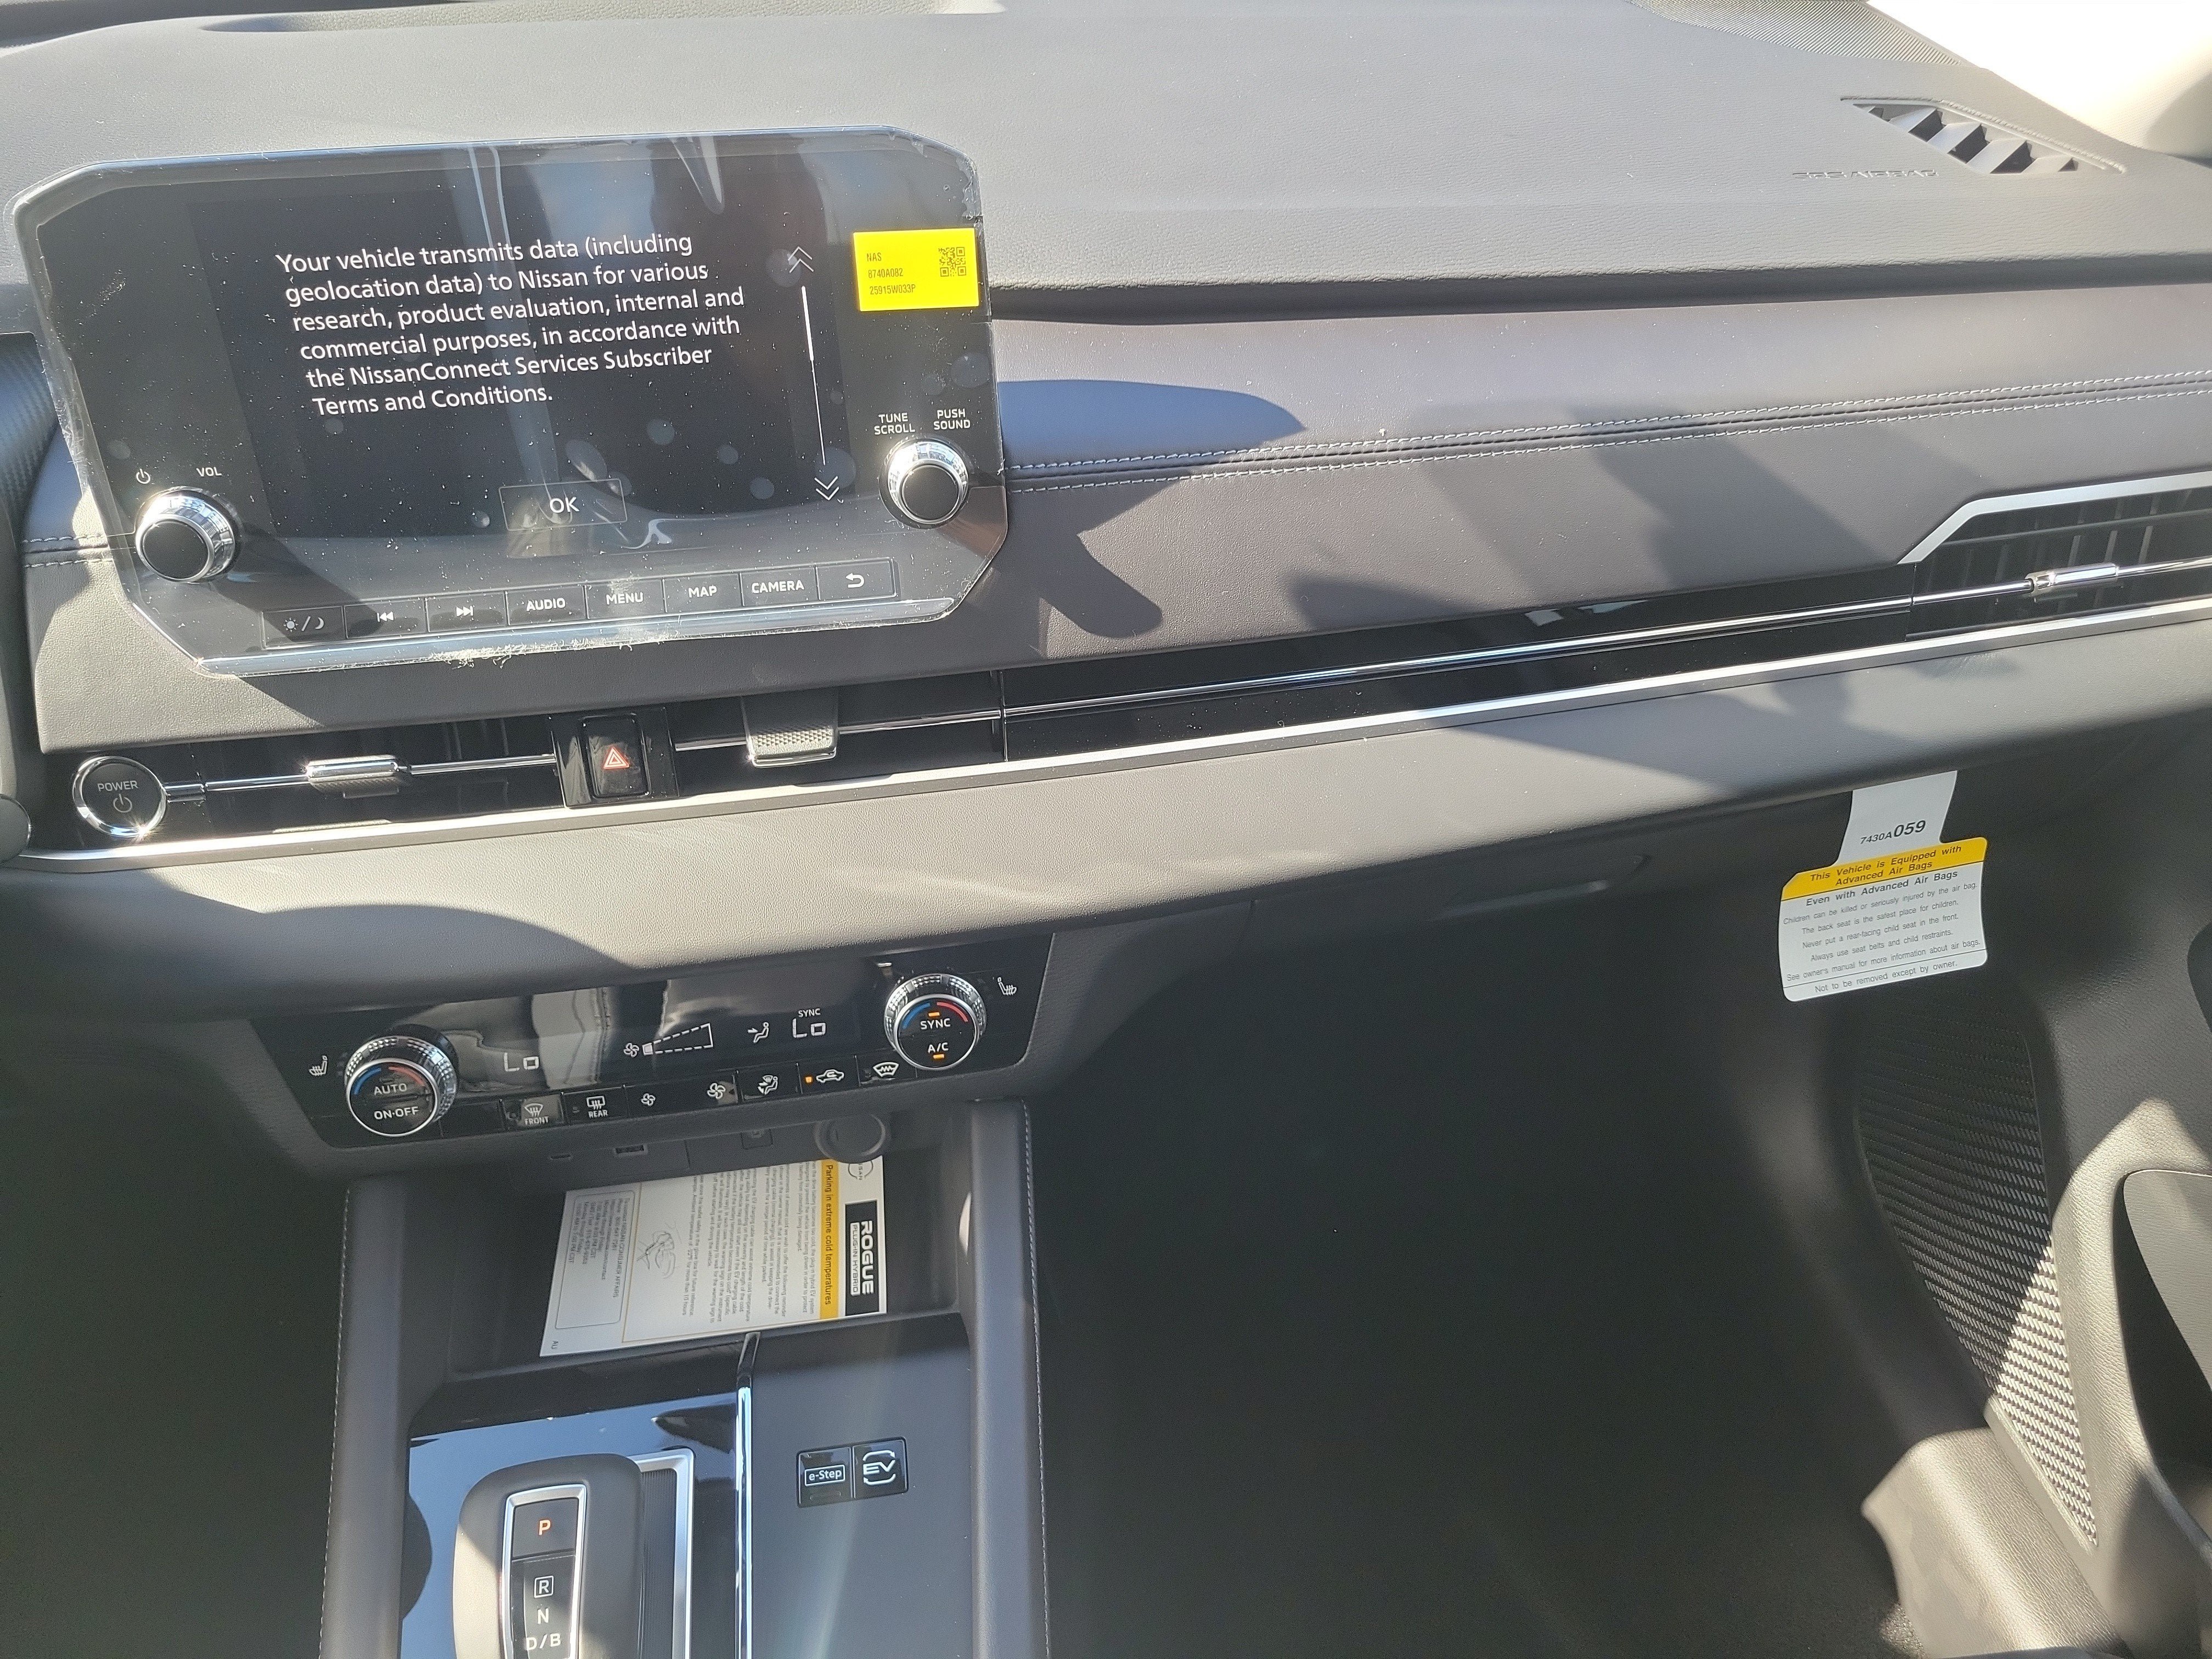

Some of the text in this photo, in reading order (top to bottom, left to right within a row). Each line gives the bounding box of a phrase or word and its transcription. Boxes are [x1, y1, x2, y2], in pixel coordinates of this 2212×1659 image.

[275, 233, 692, 273] Your vehicle transmits data (including
[867, 252, 882, 262] NAS
[868, 268, 904, 278] 8740A082
[285, 262, 709, 307] geolocation data) to Nissan for various
[870, 284, 916, 295] 25915W033P
[292, 286, 744, 331] research, product evaluation, internal and
[300, 315, 740, 359] commercial purposes, in accordance with
[305, 346, 712, 388] the NissanConnect Services Subscriber
[312, 385, 552, 415] Terms and Conditions.
[878, 413, 909, 424] TUNE
[937, 408, 966, 419] PUSH
[874, 424, 916, 435] SCROLL
[933, 419, 970, 430] SOUND
[196, 467, 222, 477] VOL
[549, 496, 580, 513] OK
[689, 585, 718, 599] MAP
[751, 579, 805, 594] CAMERA
[526, 597, 567, 612] AUDIO
[606, 592, 644, 606] MENU
[98, 780, 138, 792] POWER
[1861, 820, 1926, 844] 7430A059
[1810, 872, 1831, 881] This
[1837, 864, 1871, 876] Vehicle
[1891, 850, 1937, 865] Equipped
[1942, 845, 1961, 855] with
[1835, 862, 1933, 886] Advanced Air Bags
[1805, 871, 1957, 906] Even with Advanced Air Bags
[1783, 915, 1810, 925] Children
[1841, 904, 1858, 913] killed
[1870, 897, 1899, 908] seriously
[1902, 891, 1924, 902] injured
[1818, 923, 1833, 932] back
[1836, 920, 1851, 928] seat
[1876, 911, 1896, 921] safest
[1899, 908, 1916, 918] place
[1932, 900, 1959, 910] children.
[1802, 940, 1822, 949] Never
[1825, 936, 1836, 945] put
[1847, 929, 1881, 940] rear-facing
[1884, 924, 1899, 933] child
[1902, 921, 1916, 929] seat
[1942, 913, 1959, 922] front.
[1811, 952, 1834, 961] Always
[1852, 945, 1866, 954] seat
[1888, 939, 1900, 947] and
[1903, 935, 1918, 944] child
[1922, 930, 1953, 940] restraints.
[1803, 968, 1829, 978] owner's
[1831, 963, 1855, 972] manual
[1870, 957, 1887, 965] more
[1890, 950, 1926, 961] information
[1929, 945, 1948, 954] about
[1962, 939, 1980, 948] bags.
[1815, 985, 1829, 993] Not
[1856, 972, 1888, 985] removed
[1892, 967, 1916, 978] except
[1933, 961, 1957, 970] owner.
[798, 1008, 821, 1018] SYNC
[920, 1018, 951, 1030] SYNC
[928, 1041, 949, 1053] A/C
[374, 1082, 407, 1096] AUTO
[524, 1116, 549, 1125] FRONT
[588, 1108, 608, 1118] REAR
[824, 1165, 833, 1192] Parking
[825, 1235, 833, 1251] cold
[862, 1220, 874, 1295] ROGUE
[823, 1254, 833, 1305] temperatures
[809, 1467, 842, 1482] e-Step
[863, 1460, 896, 1476] EV
[538, 1520, 551, 1535] P
[539, 1580, 549, 1593] R
[538, 1609, 549, 1624] N
[526, 1634, 561, 1650] D/B
